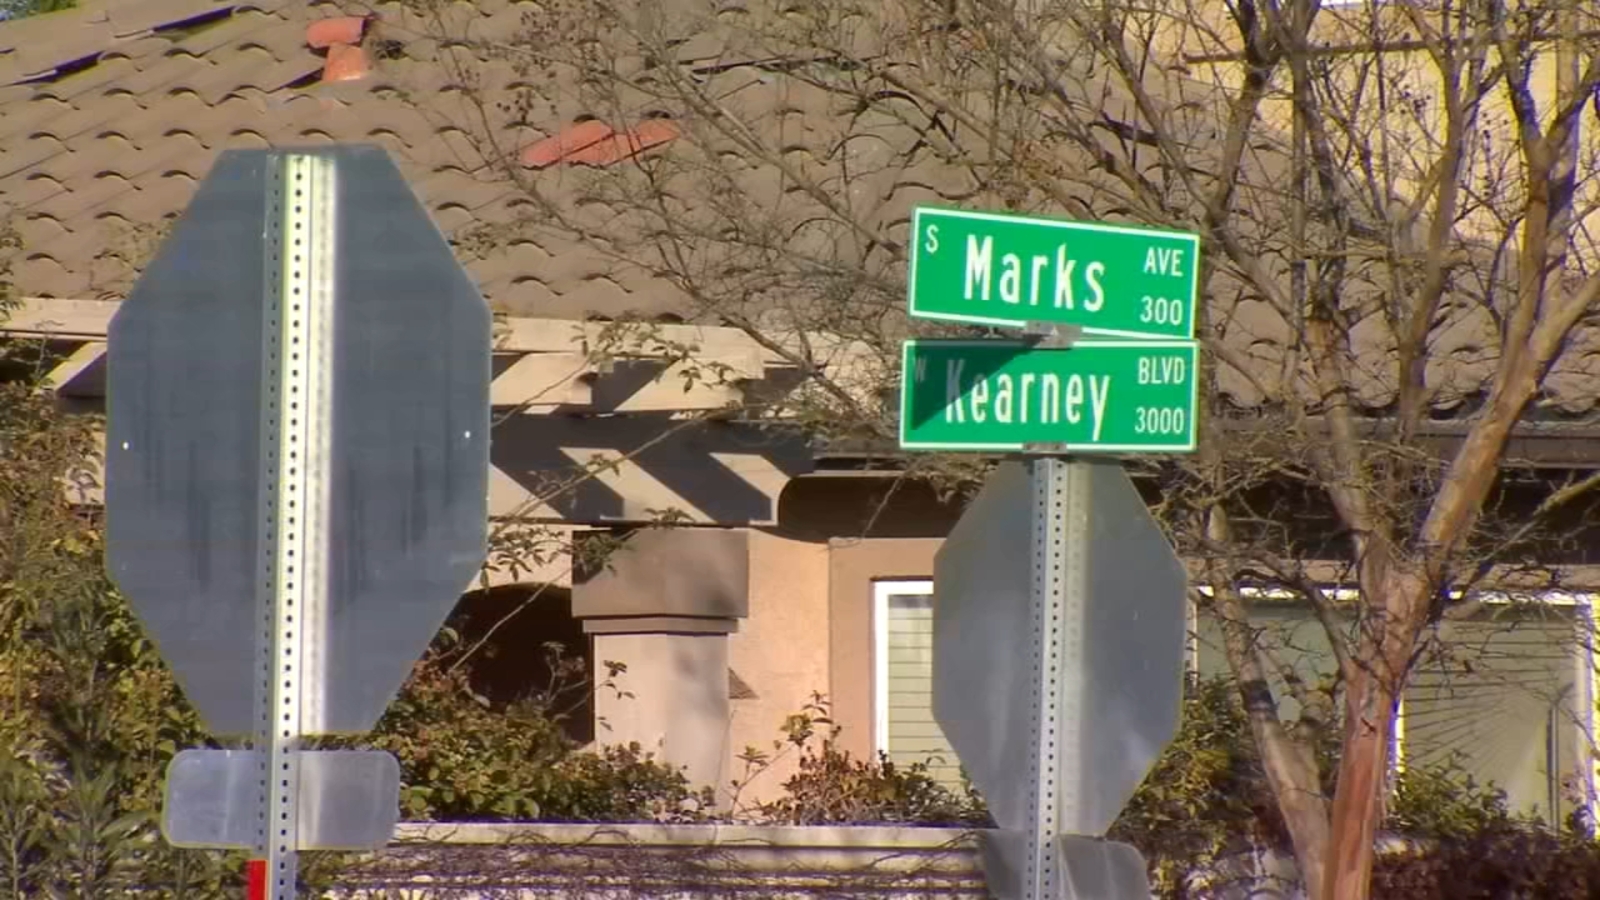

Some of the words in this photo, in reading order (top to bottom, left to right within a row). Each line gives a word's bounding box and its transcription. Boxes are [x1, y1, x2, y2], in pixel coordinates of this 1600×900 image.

[925, 224, 939, 253] S
[964, 234, 1105, 312] Marks
[1143, 246, 1183, 277] AVE
[1140, 295, 1183, 326] 300
[945, 358, 1110, 442] Kearney
[1137, 356, 1185, 385] BLVD
[1134, 407, 1184, 435] 3000
